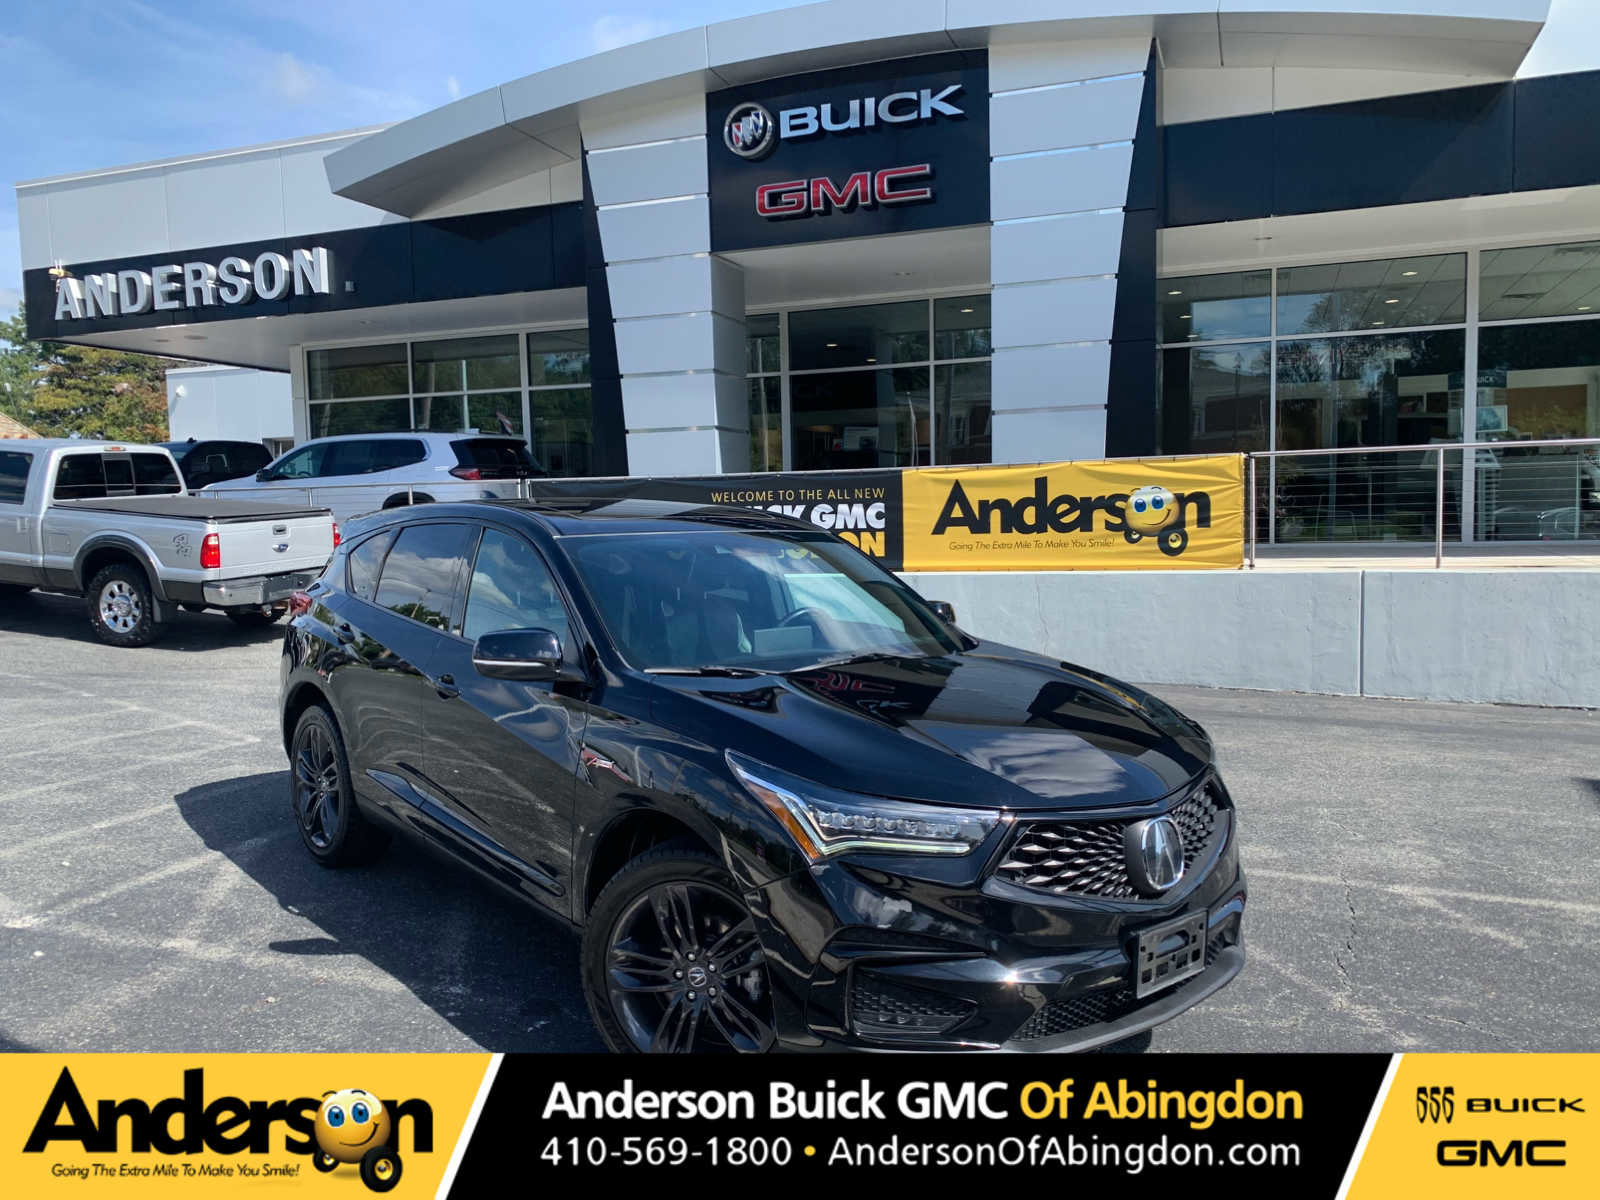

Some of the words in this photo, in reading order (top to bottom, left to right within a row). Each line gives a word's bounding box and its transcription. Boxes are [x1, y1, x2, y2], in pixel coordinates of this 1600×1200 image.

[779, 84, 965, 139] BUICK
[755, 163, 931, 217] GMC
[54, 246, 331, 321] ANDERSON
[711, 490, 774, 503] WELCOME
[778, 489, 795, 501] TO
[800, 489, 822, 500] THE
[827, 488, 850, 500] ALL
[854, 488, 886, 499] NEW
[810, 502, 886, 529] GMC
[950, 541, 973, 551] Going
[975, 541, 991, 550] The
[992, 541, 1013, 550] Extra
[1033, 540, 1044, 548] To
[1045, 540, 1069, 548] Make
[1071, 539, 1087, 548] You
[1089, 538, 1115, 548] Smile!
